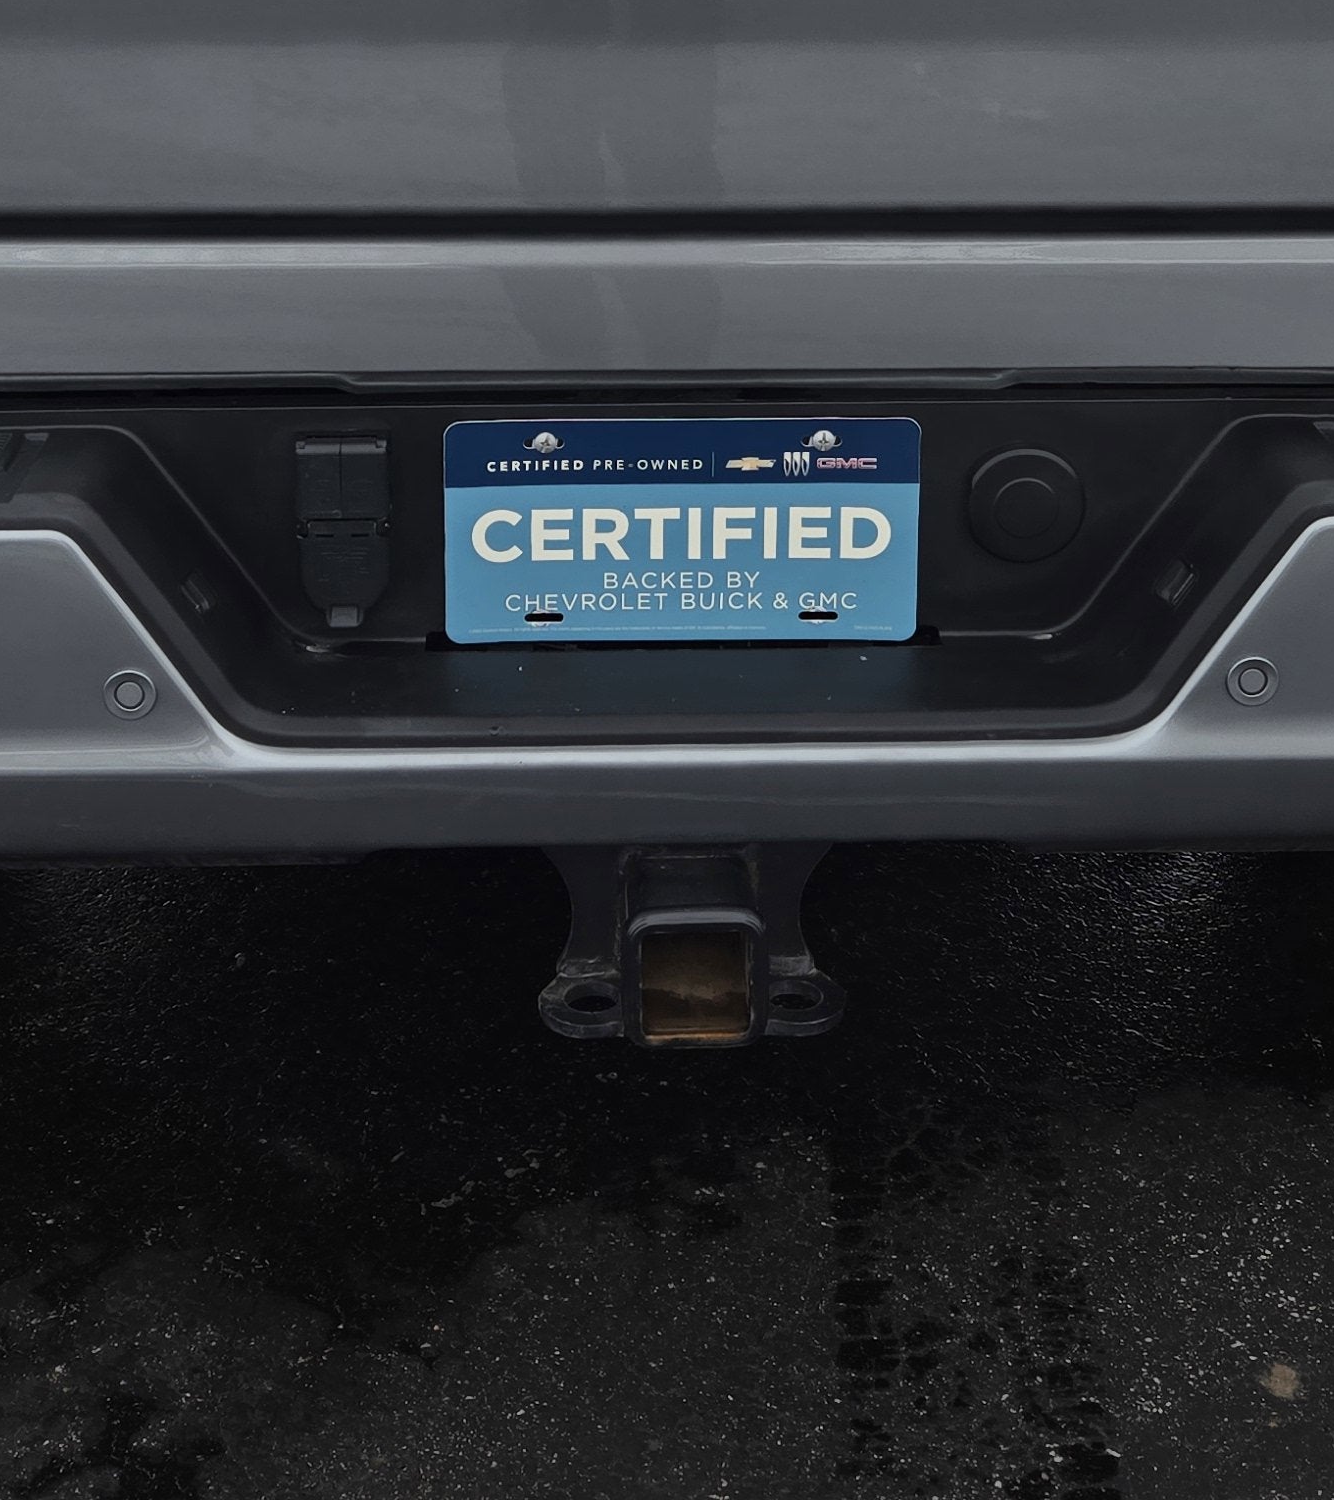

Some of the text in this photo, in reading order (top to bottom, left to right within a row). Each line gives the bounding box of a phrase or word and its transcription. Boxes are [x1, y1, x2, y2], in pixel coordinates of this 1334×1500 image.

[486, 459, 703, 473] CERTIFIED PRE-OWNED
[816, 457, 878, 470] GMC
[471, 506, 892, 563] CERTIFIED
[603, 571, 760, 589] BACKED BY
[505, 591, 858, 612] CHEVROLET BUICK & GMC
